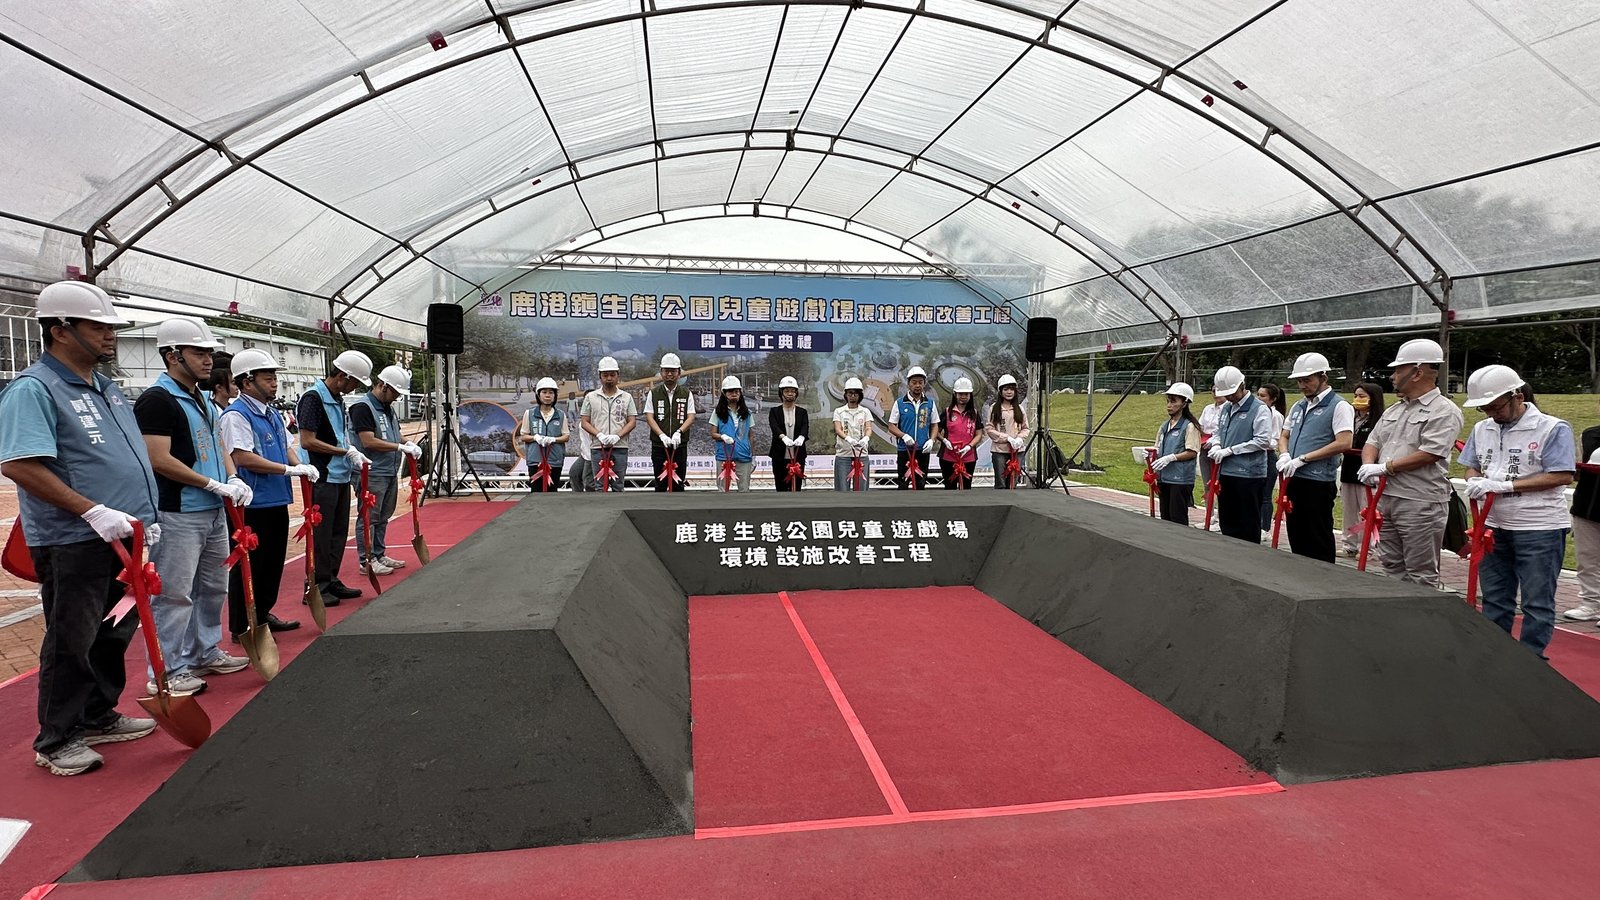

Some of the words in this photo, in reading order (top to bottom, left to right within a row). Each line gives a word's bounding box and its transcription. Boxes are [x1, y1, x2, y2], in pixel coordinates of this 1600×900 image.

[700, 333, 812, 350] 開工動土典禮
[674, 519, 970, 544] 鹿港生態公園兒童遊戲場
[719, 542, 933, 568] 環境設施改善工程
